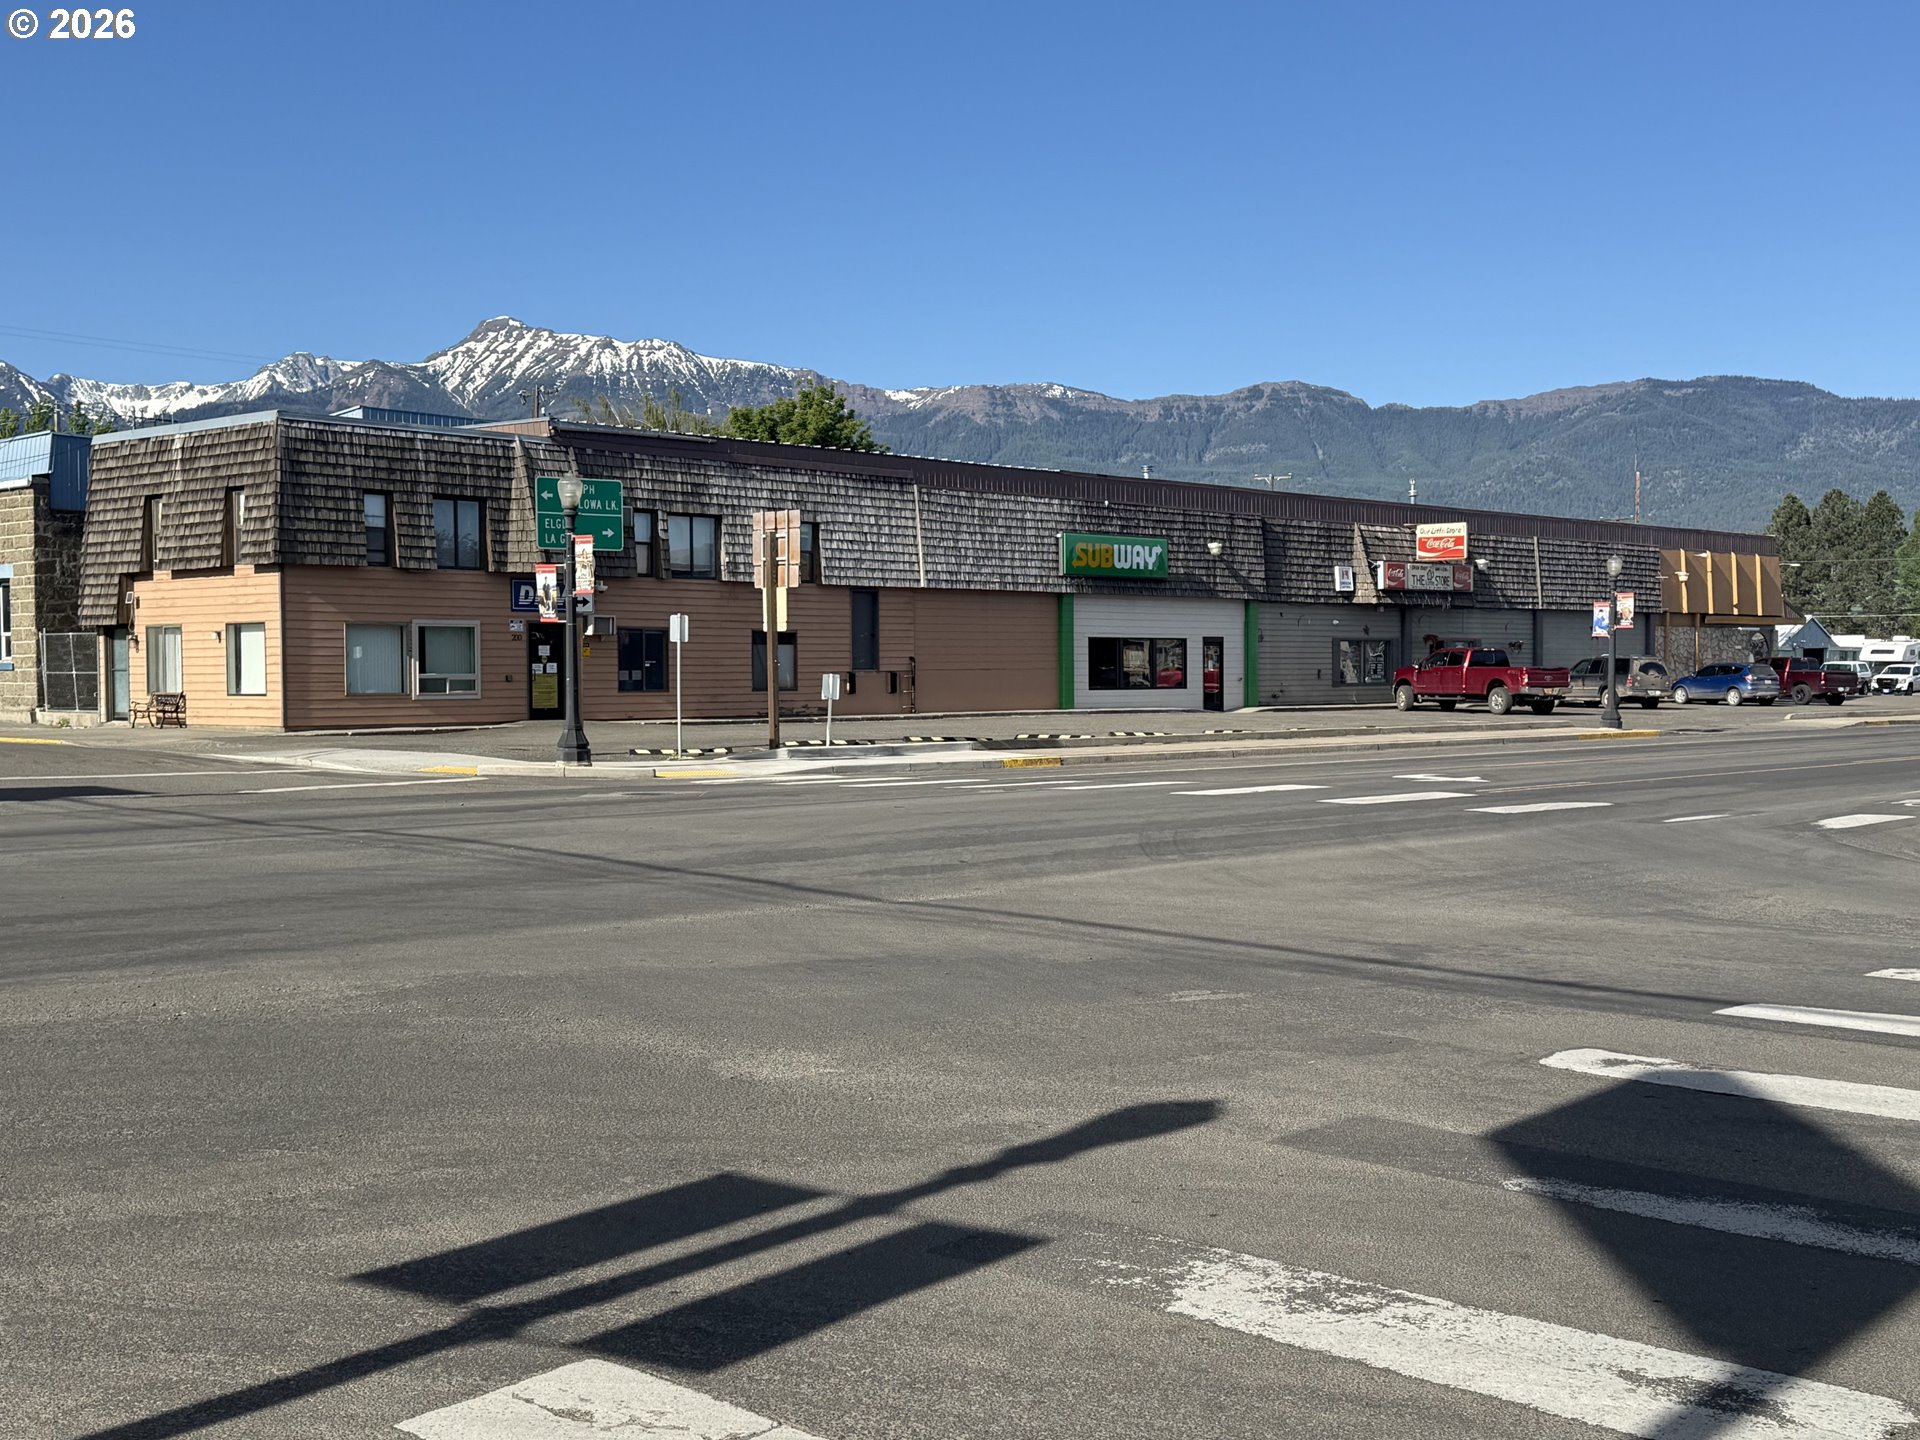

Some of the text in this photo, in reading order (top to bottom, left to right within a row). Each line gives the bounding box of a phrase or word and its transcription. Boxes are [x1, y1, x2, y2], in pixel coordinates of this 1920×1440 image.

[605, 500, 619, 511] LK.
[545, 518, 566, 529] ELGI
[545, 533, 556, 544] LA
[1072, 542, 1162, 570] SUBWAY
[1411, 574, 1425, 586] THE
[1435, 575, 1450, 587] STORE
